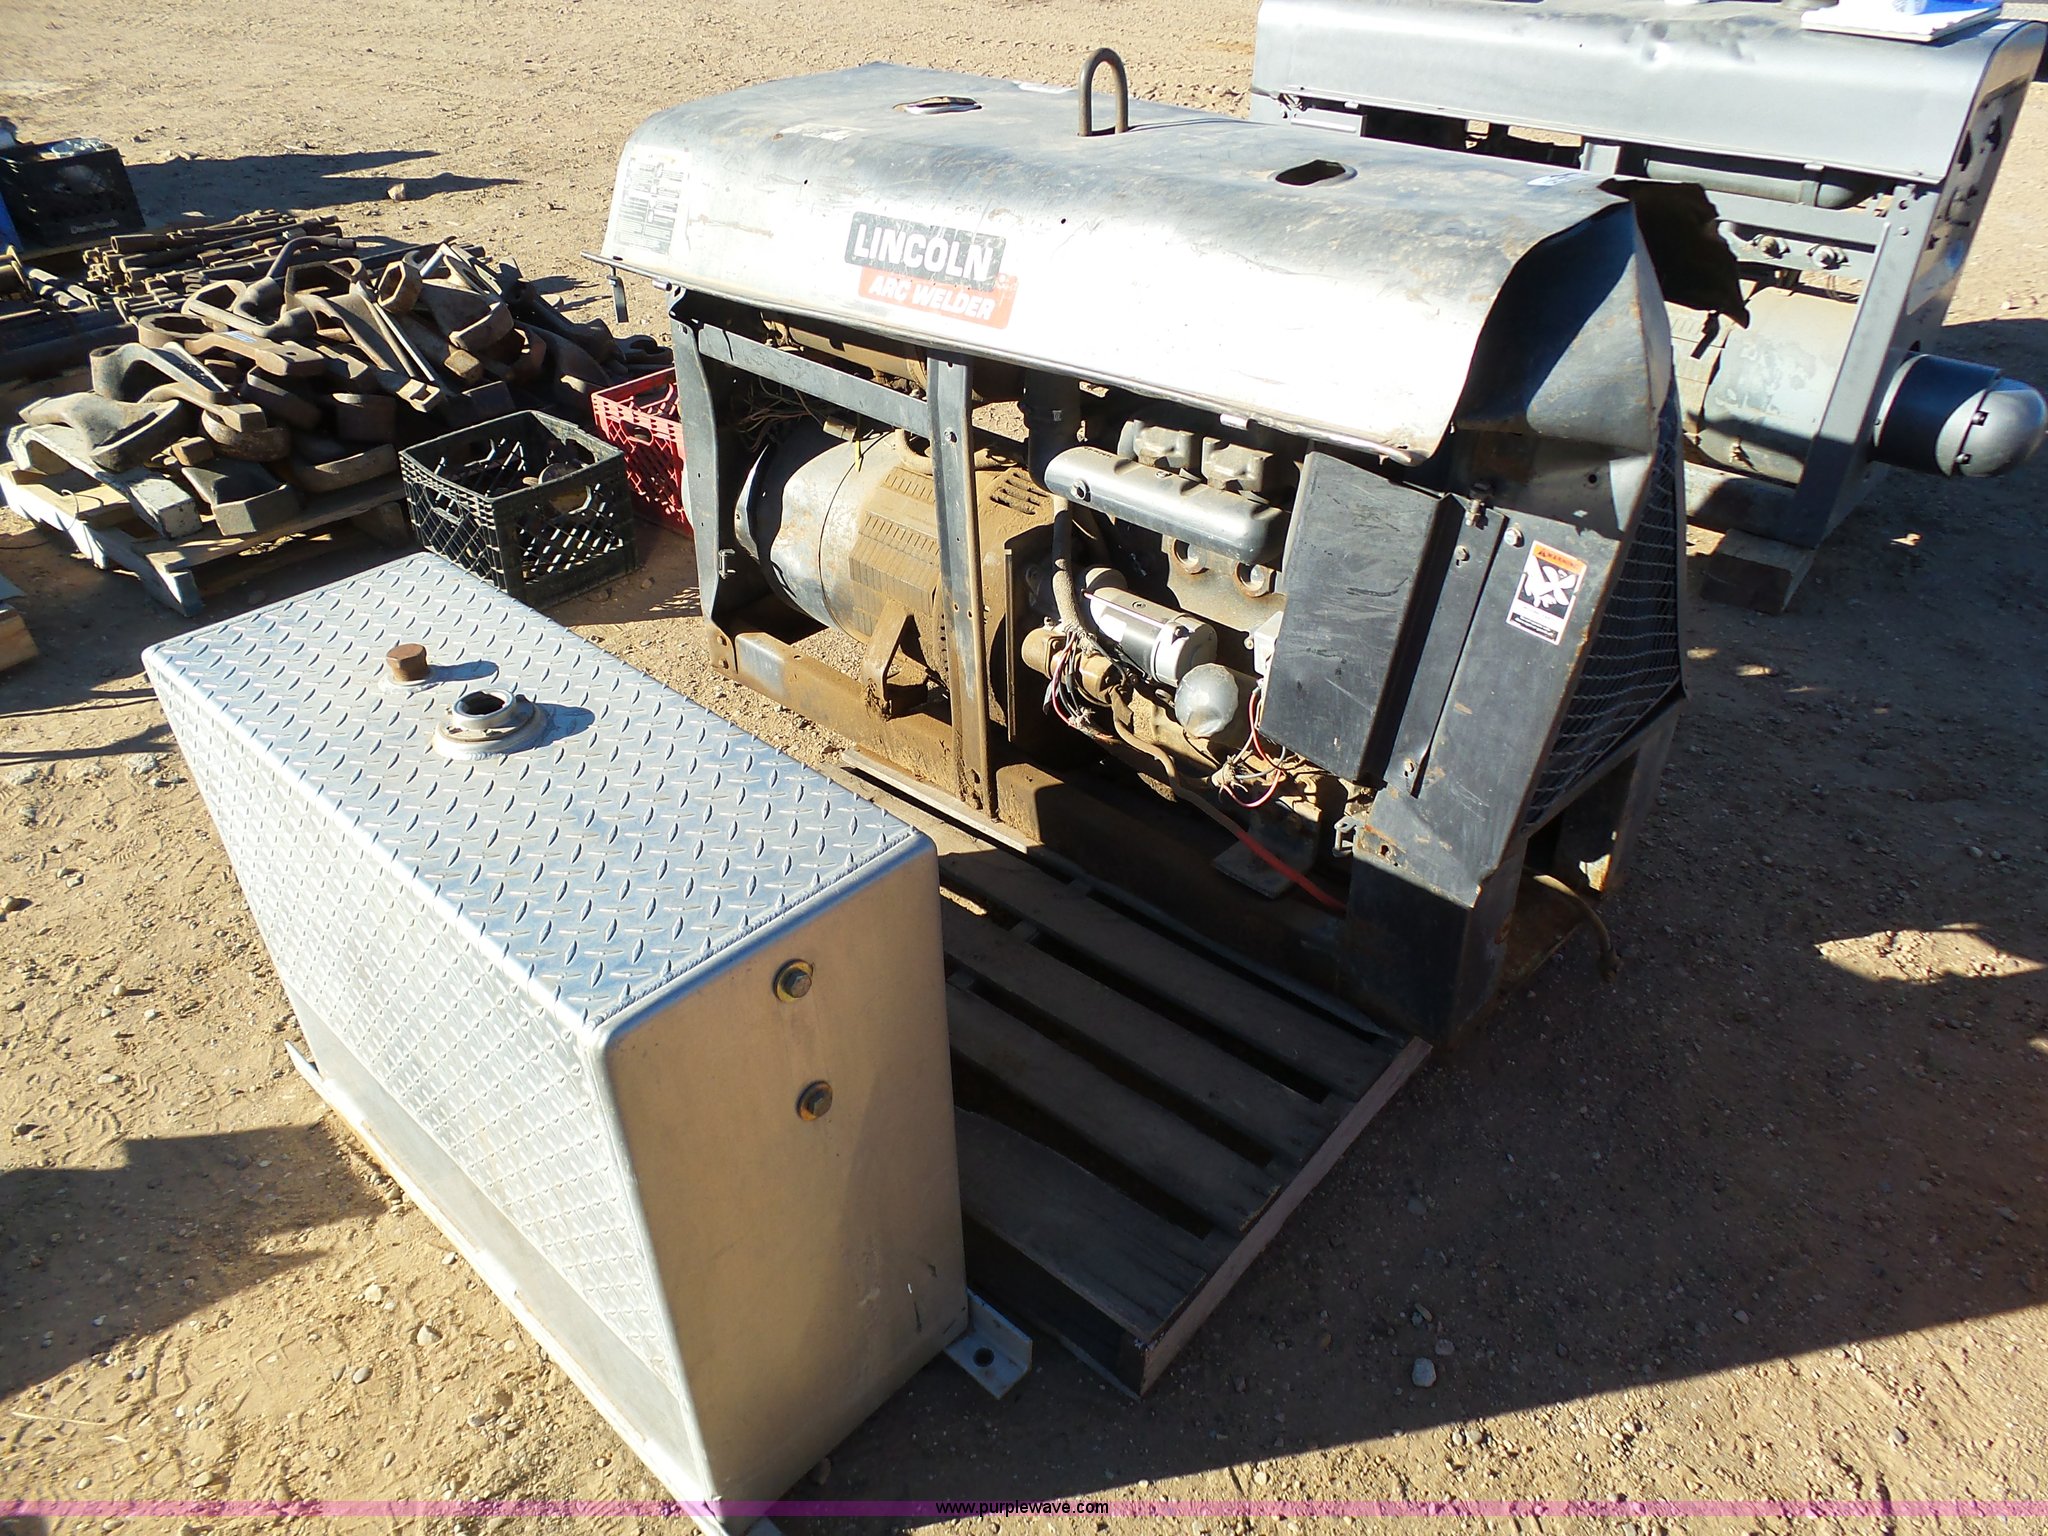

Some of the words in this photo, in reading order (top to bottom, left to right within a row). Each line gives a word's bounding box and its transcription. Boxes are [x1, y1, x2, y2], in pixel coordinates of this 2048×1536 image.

[854, 224, 993, 282] LINCOLN
[869, 275, 912, 301] ARC
[912, 284, 995, 320] WELDER
